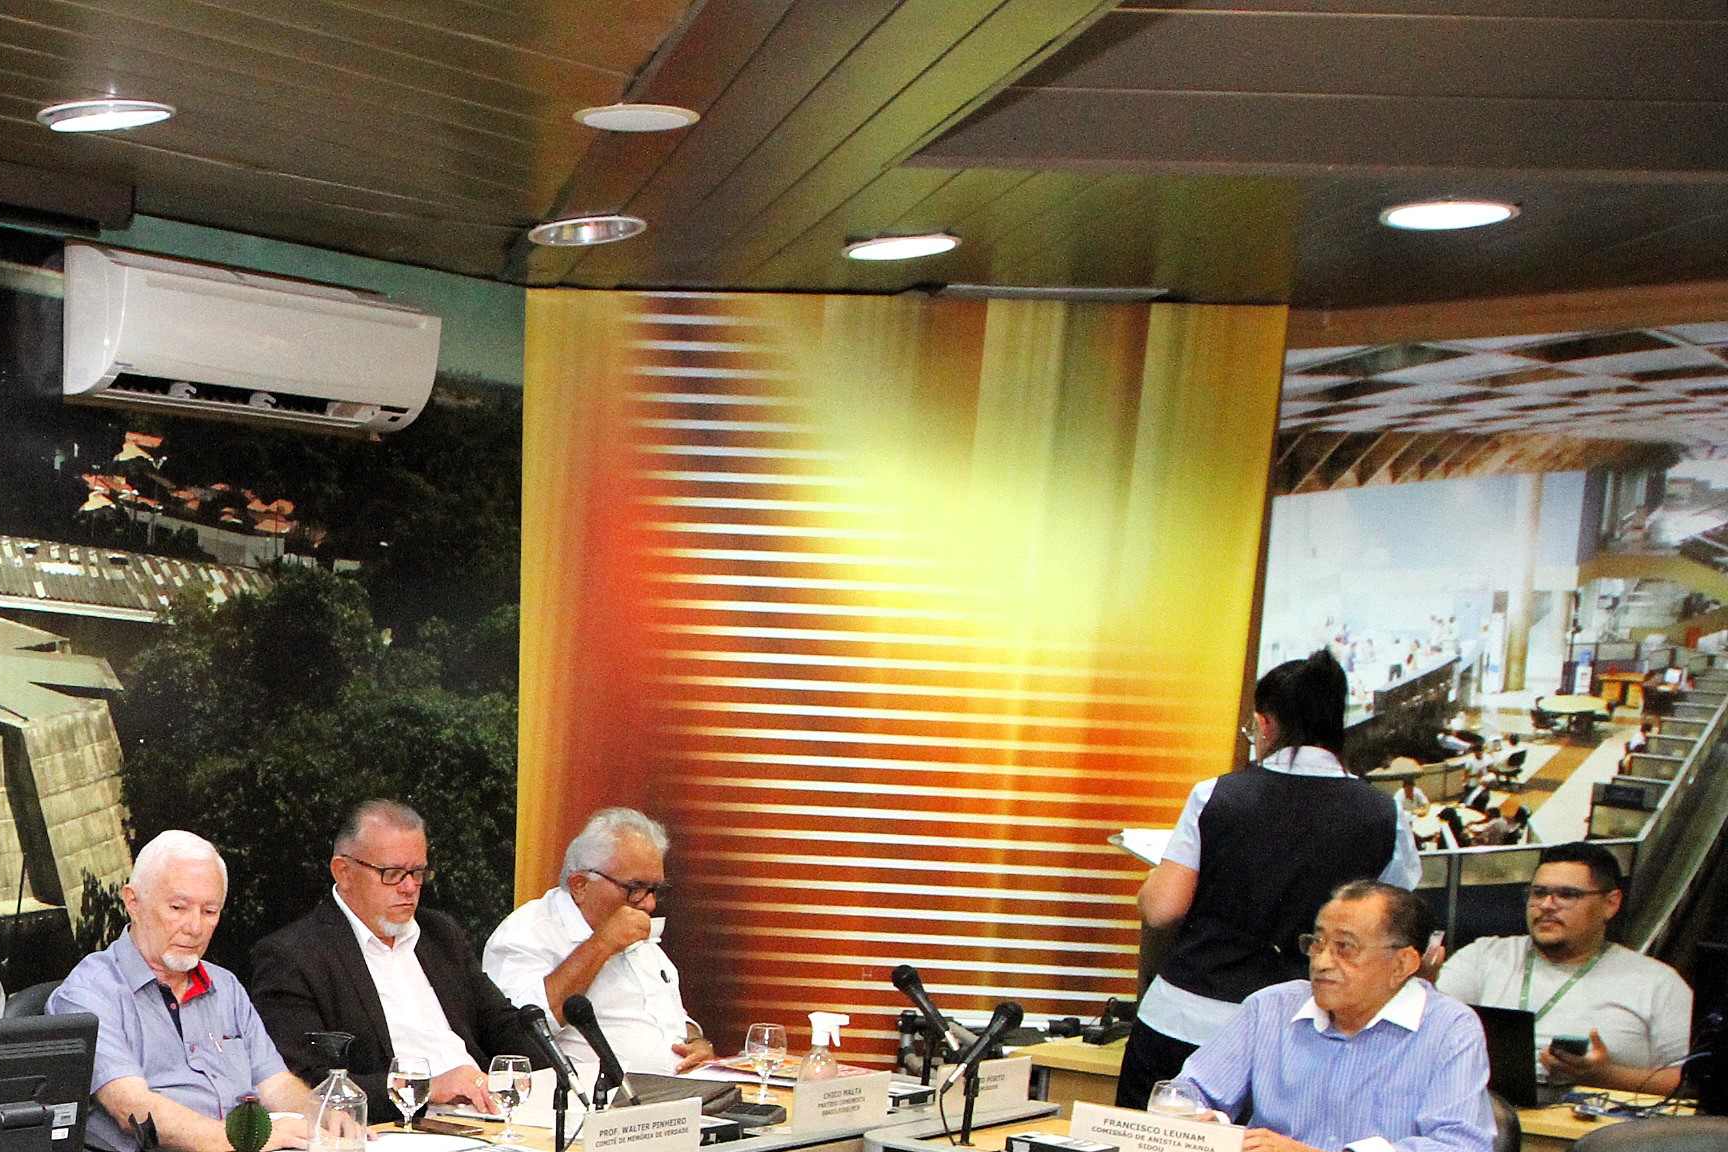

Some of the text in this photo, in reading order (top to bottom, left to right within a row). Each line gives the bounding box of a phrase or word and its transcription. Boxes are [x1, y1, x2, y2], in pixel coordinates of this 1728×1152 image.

[599, 1117, 687, 1137] PROF. WALTER PINHEIRO
[627, 1133, 653, 1141] MEMÓRIA
[663, 1127, 688, 1136] VERDADE
[1104, 1118, 1206, 1142] FRANCISCO LEUNAM
[1092, 1126, 1132, 1138] COMISSÃO
[1147, 1136, 1181, 1147] ANISTIA
[1185, 1142, 1215, 1152] WANDA
[1138, 1143, 1164, 1152] SIDOU
